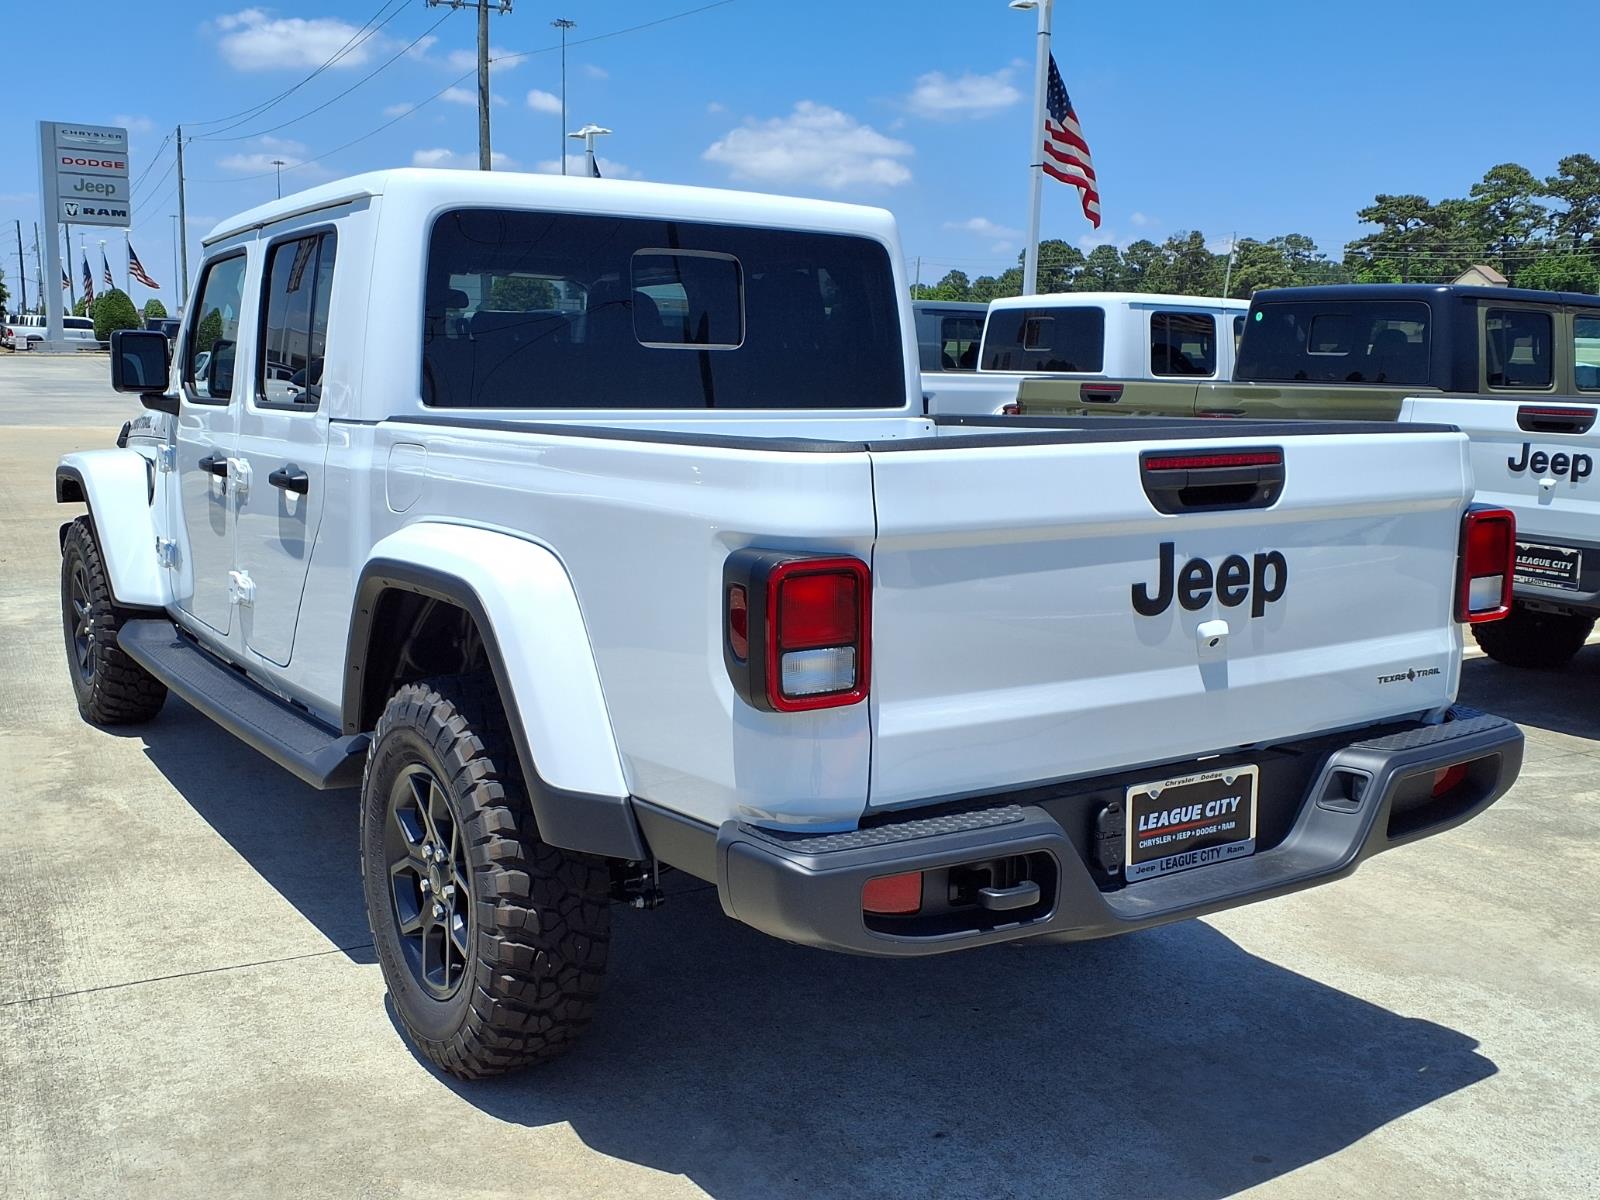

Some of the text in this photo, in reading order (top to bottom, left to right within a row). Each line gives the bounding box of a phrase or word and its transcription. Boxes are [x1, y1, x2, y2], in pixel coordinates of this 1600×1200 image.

[62, 129, 122, 140] CHRYSLER
[62, 157, 125, 169] DODGE
[73, 178, 116, 197] Jeep
[83, 207, 127, 217] RAM
[1507, 442, 1593, 483] Jeep
[1516, 555, 1574, 570] LEAGUE CITY
[1131, 541, 1288, 618] Jeep
[1377, 667, 1441, 684] TEXAS TRAIL
[1165, 773, 1223, 787] Chrysler Dodge
[1138, 796, 1241, 832] LEAGUE CITY
[1138, 821, 1236, 849] CHRYSLER JEEP DODGE RAM
[1135, 845, 1245, 875] Jeep LEAGUE CITY Ram
